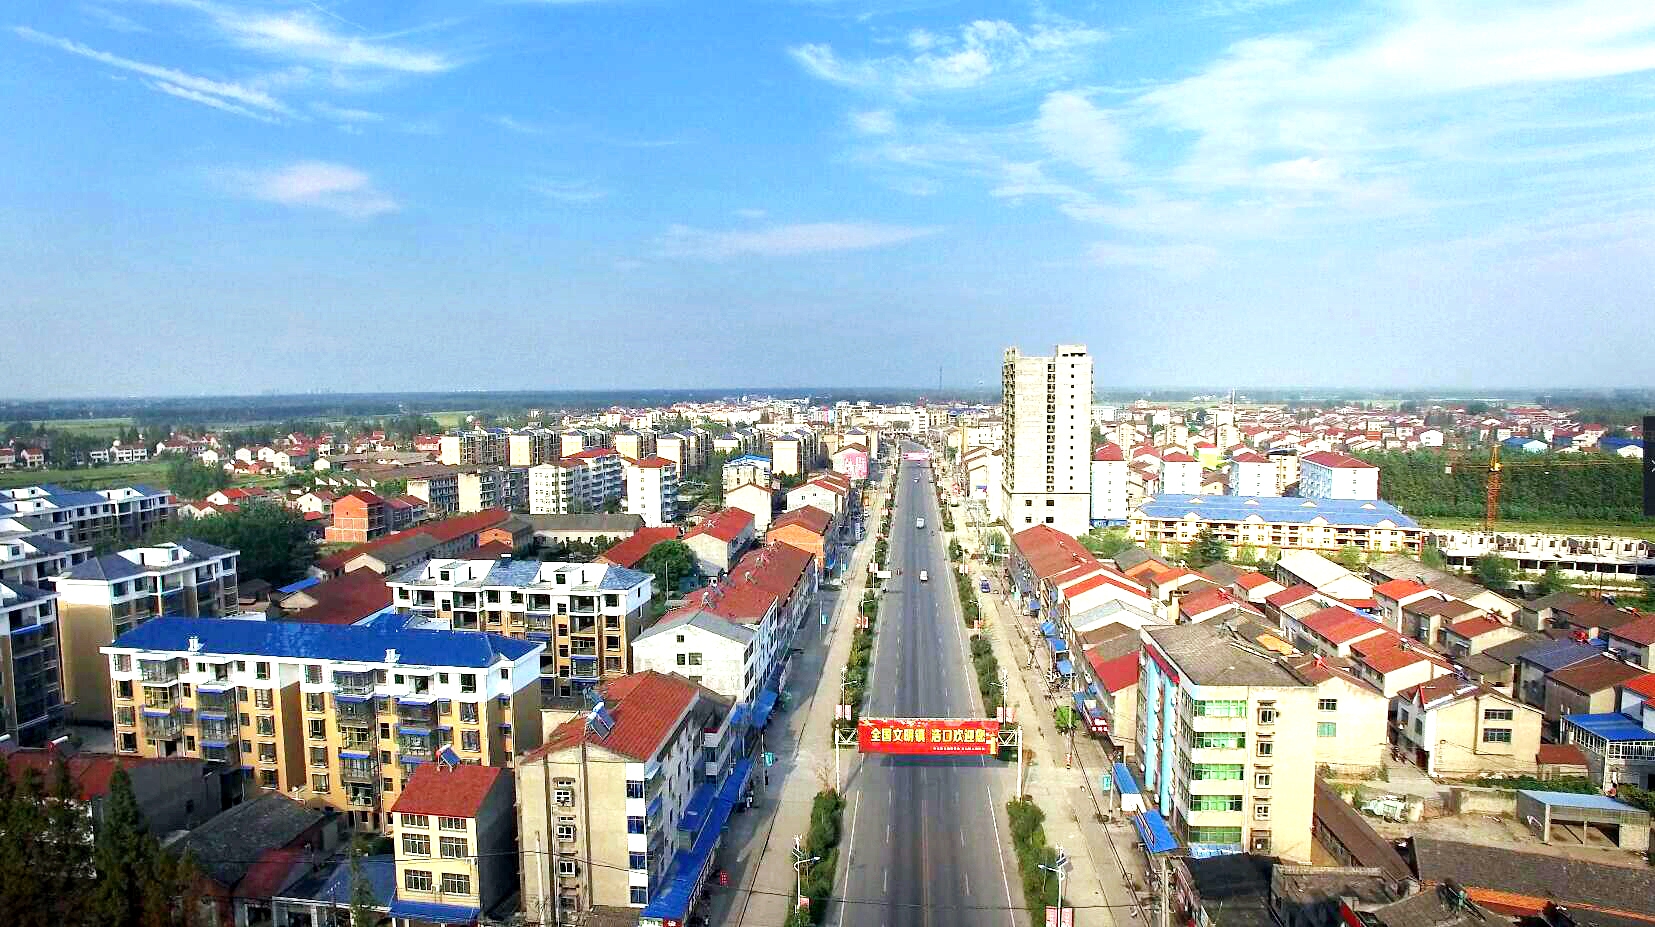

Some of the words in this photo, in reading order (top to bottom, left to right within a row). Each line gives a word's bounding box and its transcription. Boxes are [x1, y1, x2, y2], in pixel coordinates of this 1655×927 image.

[870, 728, 926, 743] 全国文明镇
